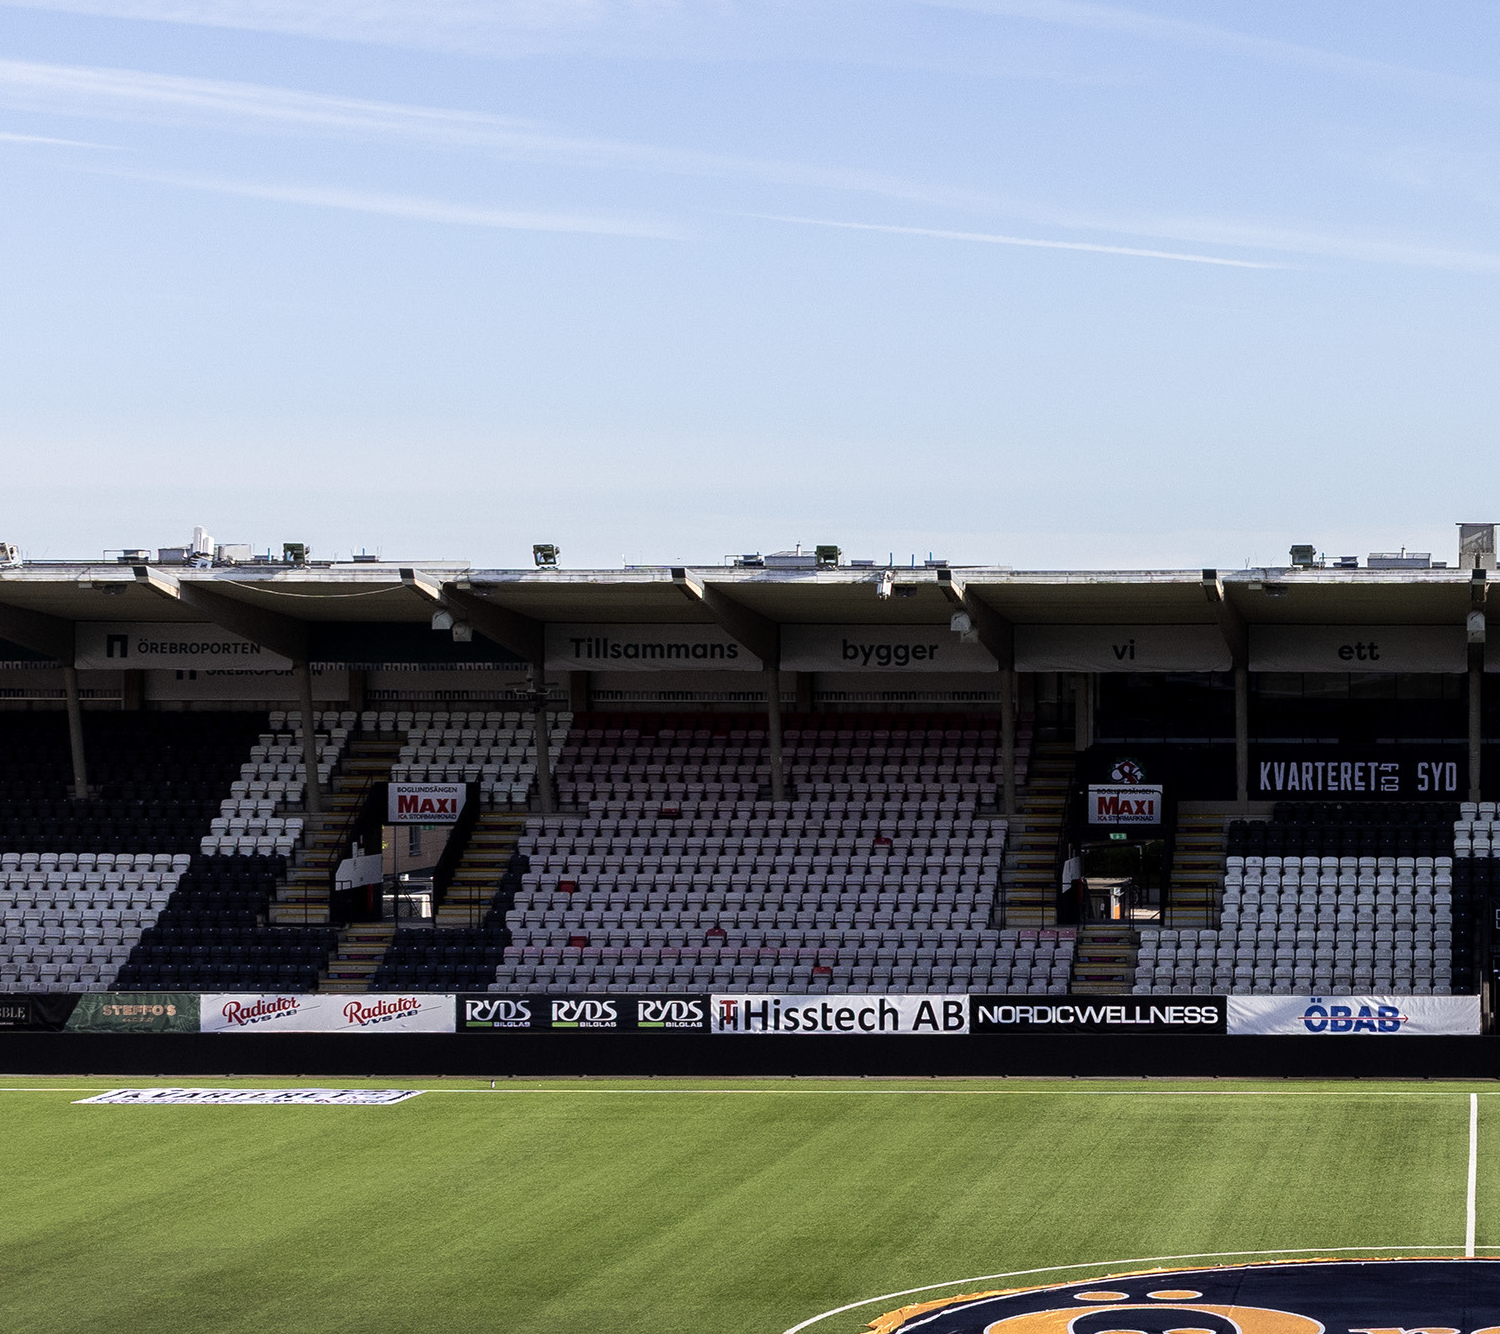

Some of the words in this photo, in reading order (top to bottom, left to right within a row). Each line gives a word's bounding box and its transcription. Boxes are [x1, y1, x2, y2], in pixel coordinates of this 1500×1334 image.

[137, 638, 261, 655] ÖREBROPORTEN
[569, 636, 739, 661] Tillsammans
[841, 638, 939, 667] bygger
[1111, 641, 1136, 660] vi
[1337, 641, 1380, 661] ett
[1260, 762, 1378, 791] KVARTERET
[1417, 762, 1457, 791] SYD
[102, 1004, 176, 1016] STEFFO'S
[222, 996, 300, 1025] Radiator
[343, 996, 421, 1025] Radiator
[465, 1000, 531, 1021] RYDS
[552, 1000, 618, 1021] RYDS
[638, 1000, 704, 1021] RYDS
[745, 999, 899, 1032] Hisstech
[912, 1001, 965, 1031] AB
[1303, 997, 1401, 1033] ÖBAB
